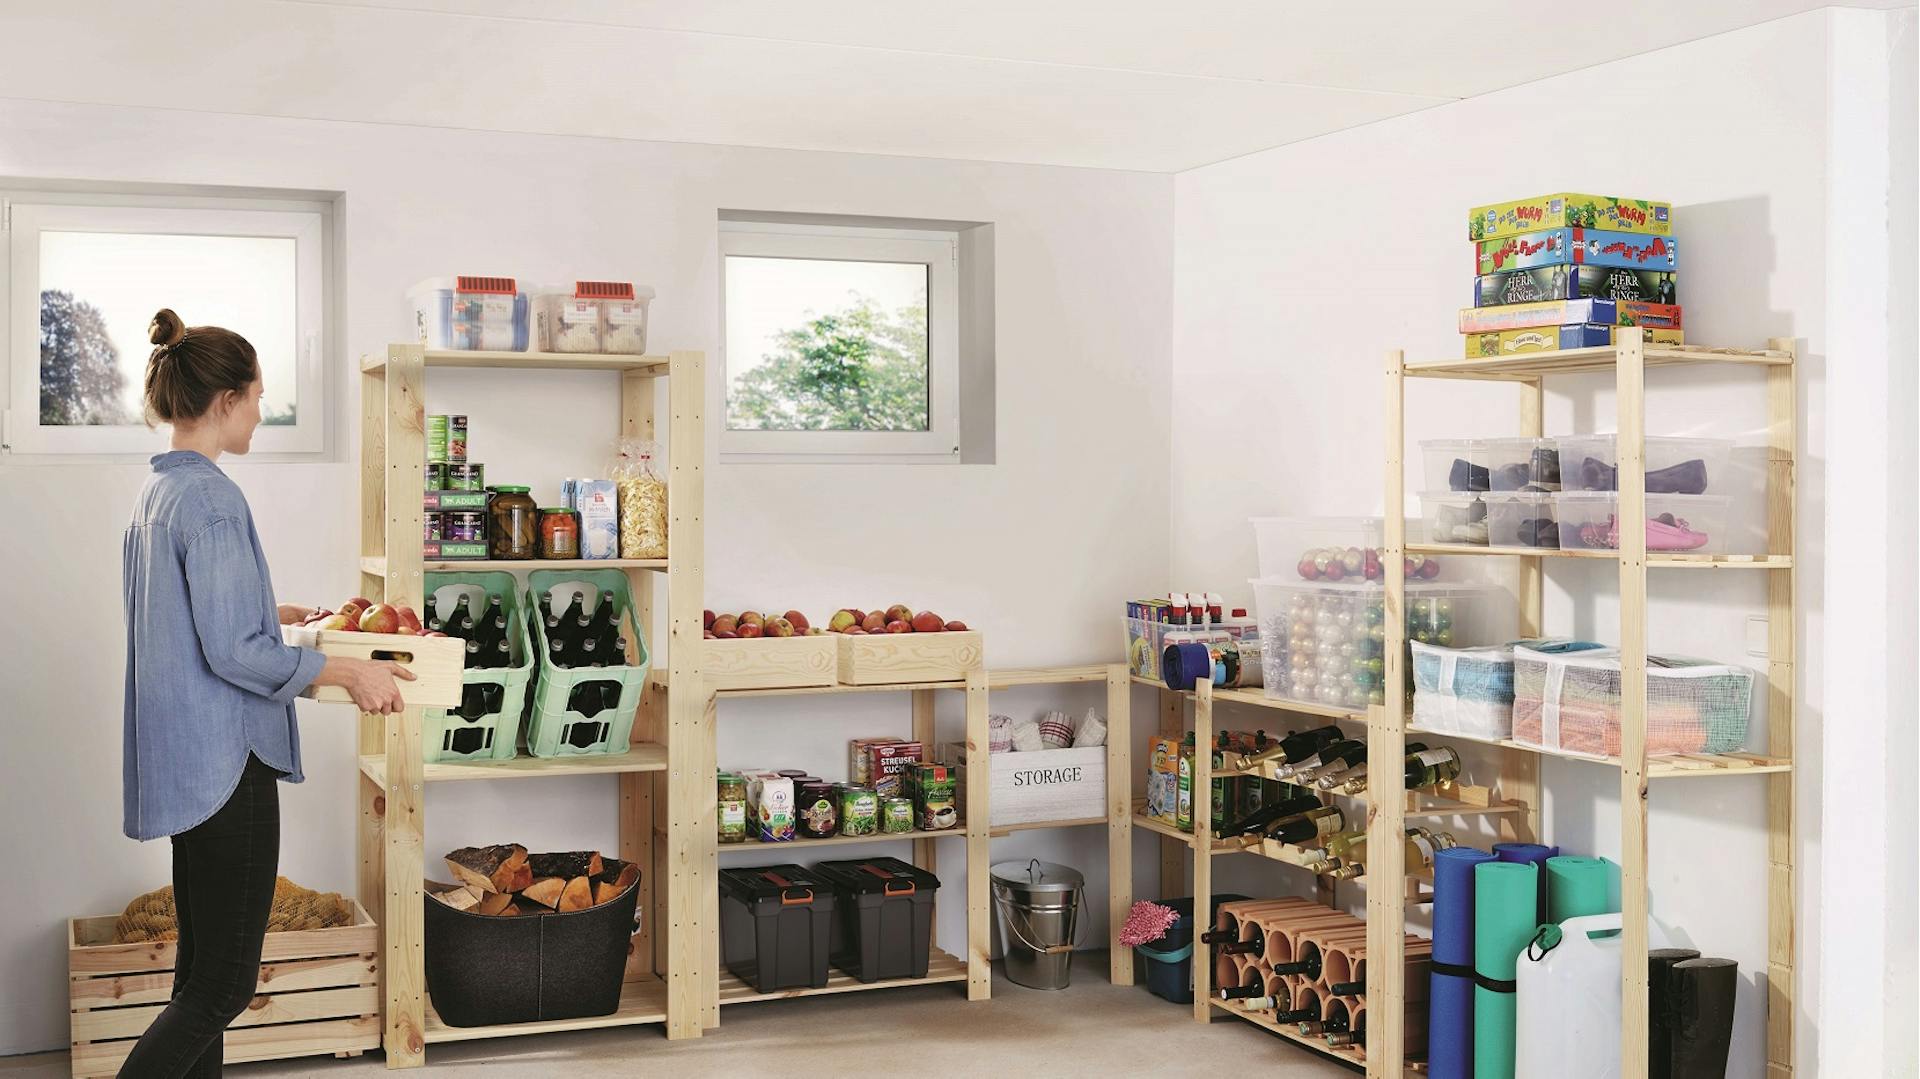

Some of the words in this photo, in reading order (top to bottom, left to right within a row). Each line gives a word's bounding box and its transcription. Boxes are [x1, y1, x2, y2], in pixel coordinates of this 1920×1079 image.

[1516, 206, 1543, 222] WURM
[1617, 205, 1646, 225] WURM
[1508, 274, 1533, 289] HERR
[1609, 273, 1639, 287] HERR
[881, 756, 916, 766] STREUSEL
[1014, 767, 1082, 786] STORAGE
